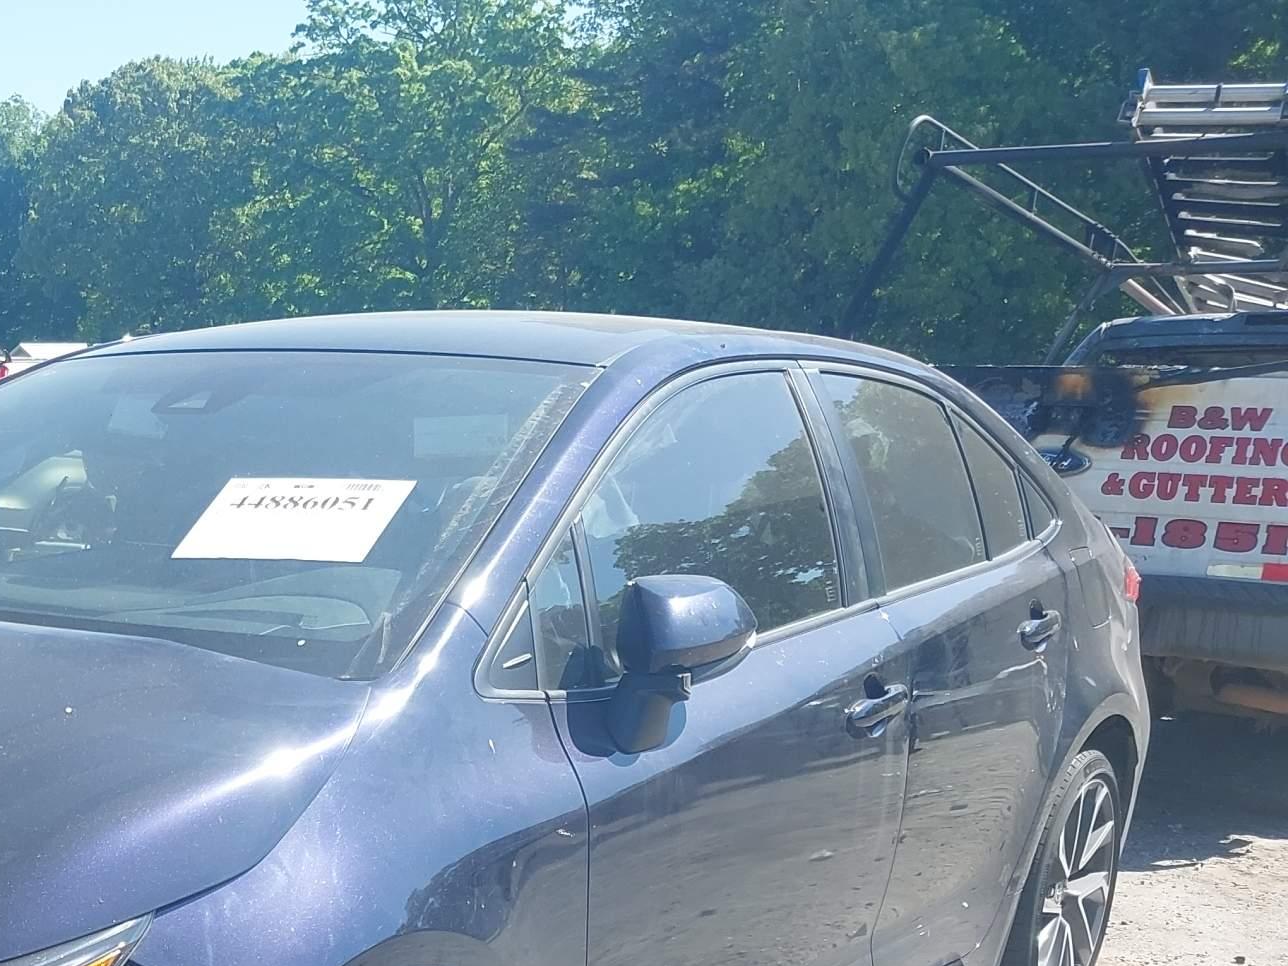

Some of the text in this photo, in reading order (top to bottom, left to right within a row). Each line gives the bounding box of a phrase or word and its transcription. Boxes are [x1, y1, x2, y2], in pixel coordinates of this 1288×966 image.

[1168, 405, 1273, 431] B&W
[1120, 433, 1288, 467] ROOFIN
[230, 495, 375, 511] 44886051
